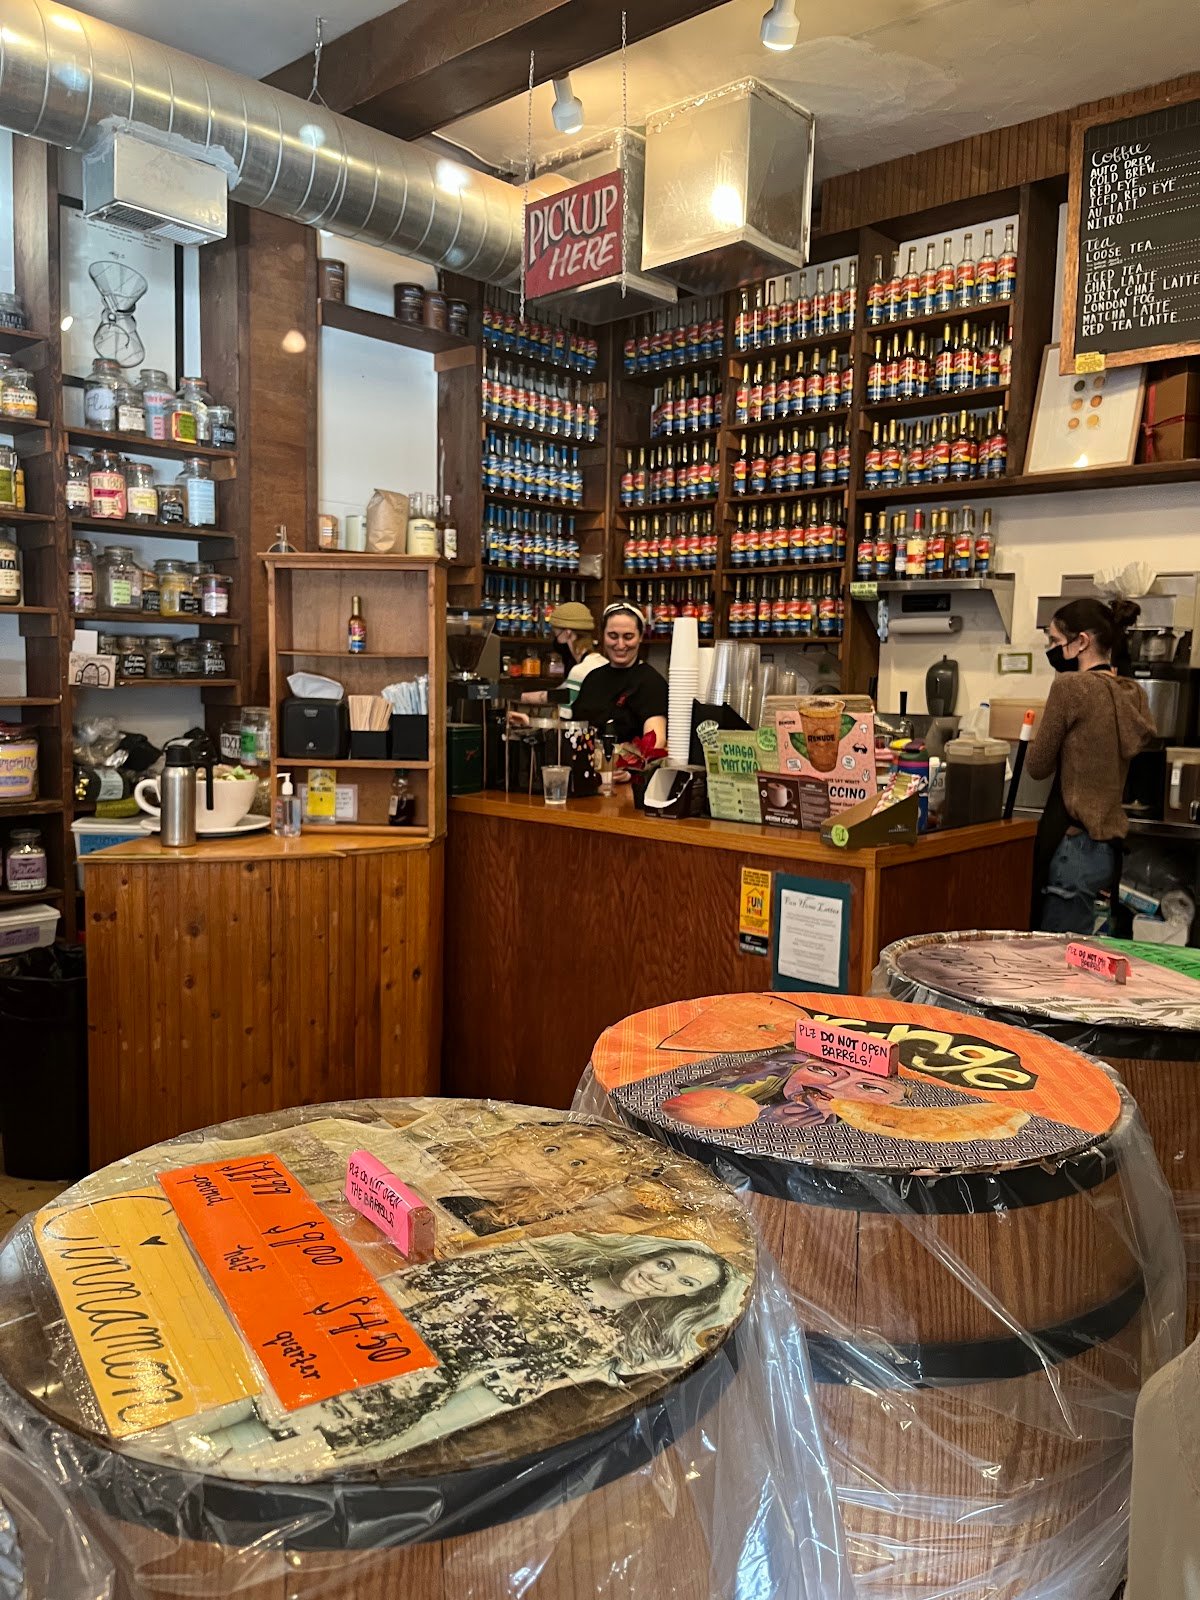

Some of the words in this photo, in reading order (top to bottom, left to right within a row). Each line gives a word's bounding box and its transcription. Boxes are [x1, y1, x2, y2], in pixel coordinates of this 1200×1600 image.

[1090, 163, 1118, 178] AUTO
[1124, 155, 1152, 170] DRIP
[1091, 143, 1151, 168] Coffee
[1089, 172, 1119, 188] COLD
[1125, 161, 1156, 180] BREW
[1088, 192, 1118, 209] ICED
[1124, 186, 1147, 200] RED
[1152, 179, 1177, 195] EYE
[1089, 184, 1112, 198] RED
[1117, 177, 1140, 191] EYE
[1088, 207, 1103, 219] AU
[1110, 198, 1138, 214] LAIT
[1087, 212, 1124, 231] NITRO
[548, 231, 618, 281] HERE
[1082, 237, 1116, 253] Tea
[1086, 246, 1122, 263] LOOSE
[1129, 240, 1153, 254] TEA
[1084, 279, 1114, 294] CHAI
[1121, 270, 1158, 287] LATTE
[1085, 269, 1116, 284] ICED
[1122, 263, 1143, 277] TEA
[1084, 287, 1121, 305] DIRTY
[1124, 282, 1155, 297] CHAI
[1162, 274, 1200, 291] LATTE
[1082, 308, 1126, 325] MATCHA
[1132, 300, 1171, 318] LATTE
[1083, 297, 1128, 315] LONDON
[1132, 293, 1155, 306] FOG
[1082, 323, 1105, 337] RED
[1111, 319, 1133, 331] TEA
[1140, 312, 1178, 328] LATTE
[807, 733, 836, 743] RENUDE
[722, 744, 753, 757] CHAGA
[720, 758, 759, 773] MATCHA
[747, 896, 763, 909] FUN
[1078, 949, 1086, 959] DO
[1087, 953, 1097, 962] NOT
[799, 1024, 816, 1039] PLZ
[820, 1031, 834, 1043] DO
[838, 1034, 859, 1050] NOT
[861, 1041, 888, 1058] OPEN
[821, 1044, 873, 1068] BARRELS!
[350, 1180, 363, 1202] THE
[369, 1176, 384, 1193] NOT
[382, 1187, 403, 1210] OPEN
[177, 1174, 233, 1207] pound
[223, 1244, 267, 1273] half
[262, 1331, 321, 1380] quarter
[262, 1221, 343, 1266] $9.00
[303, 1296, 412, 1363] $4.50
[43, 1195, 184, 1425] Cinnamon
